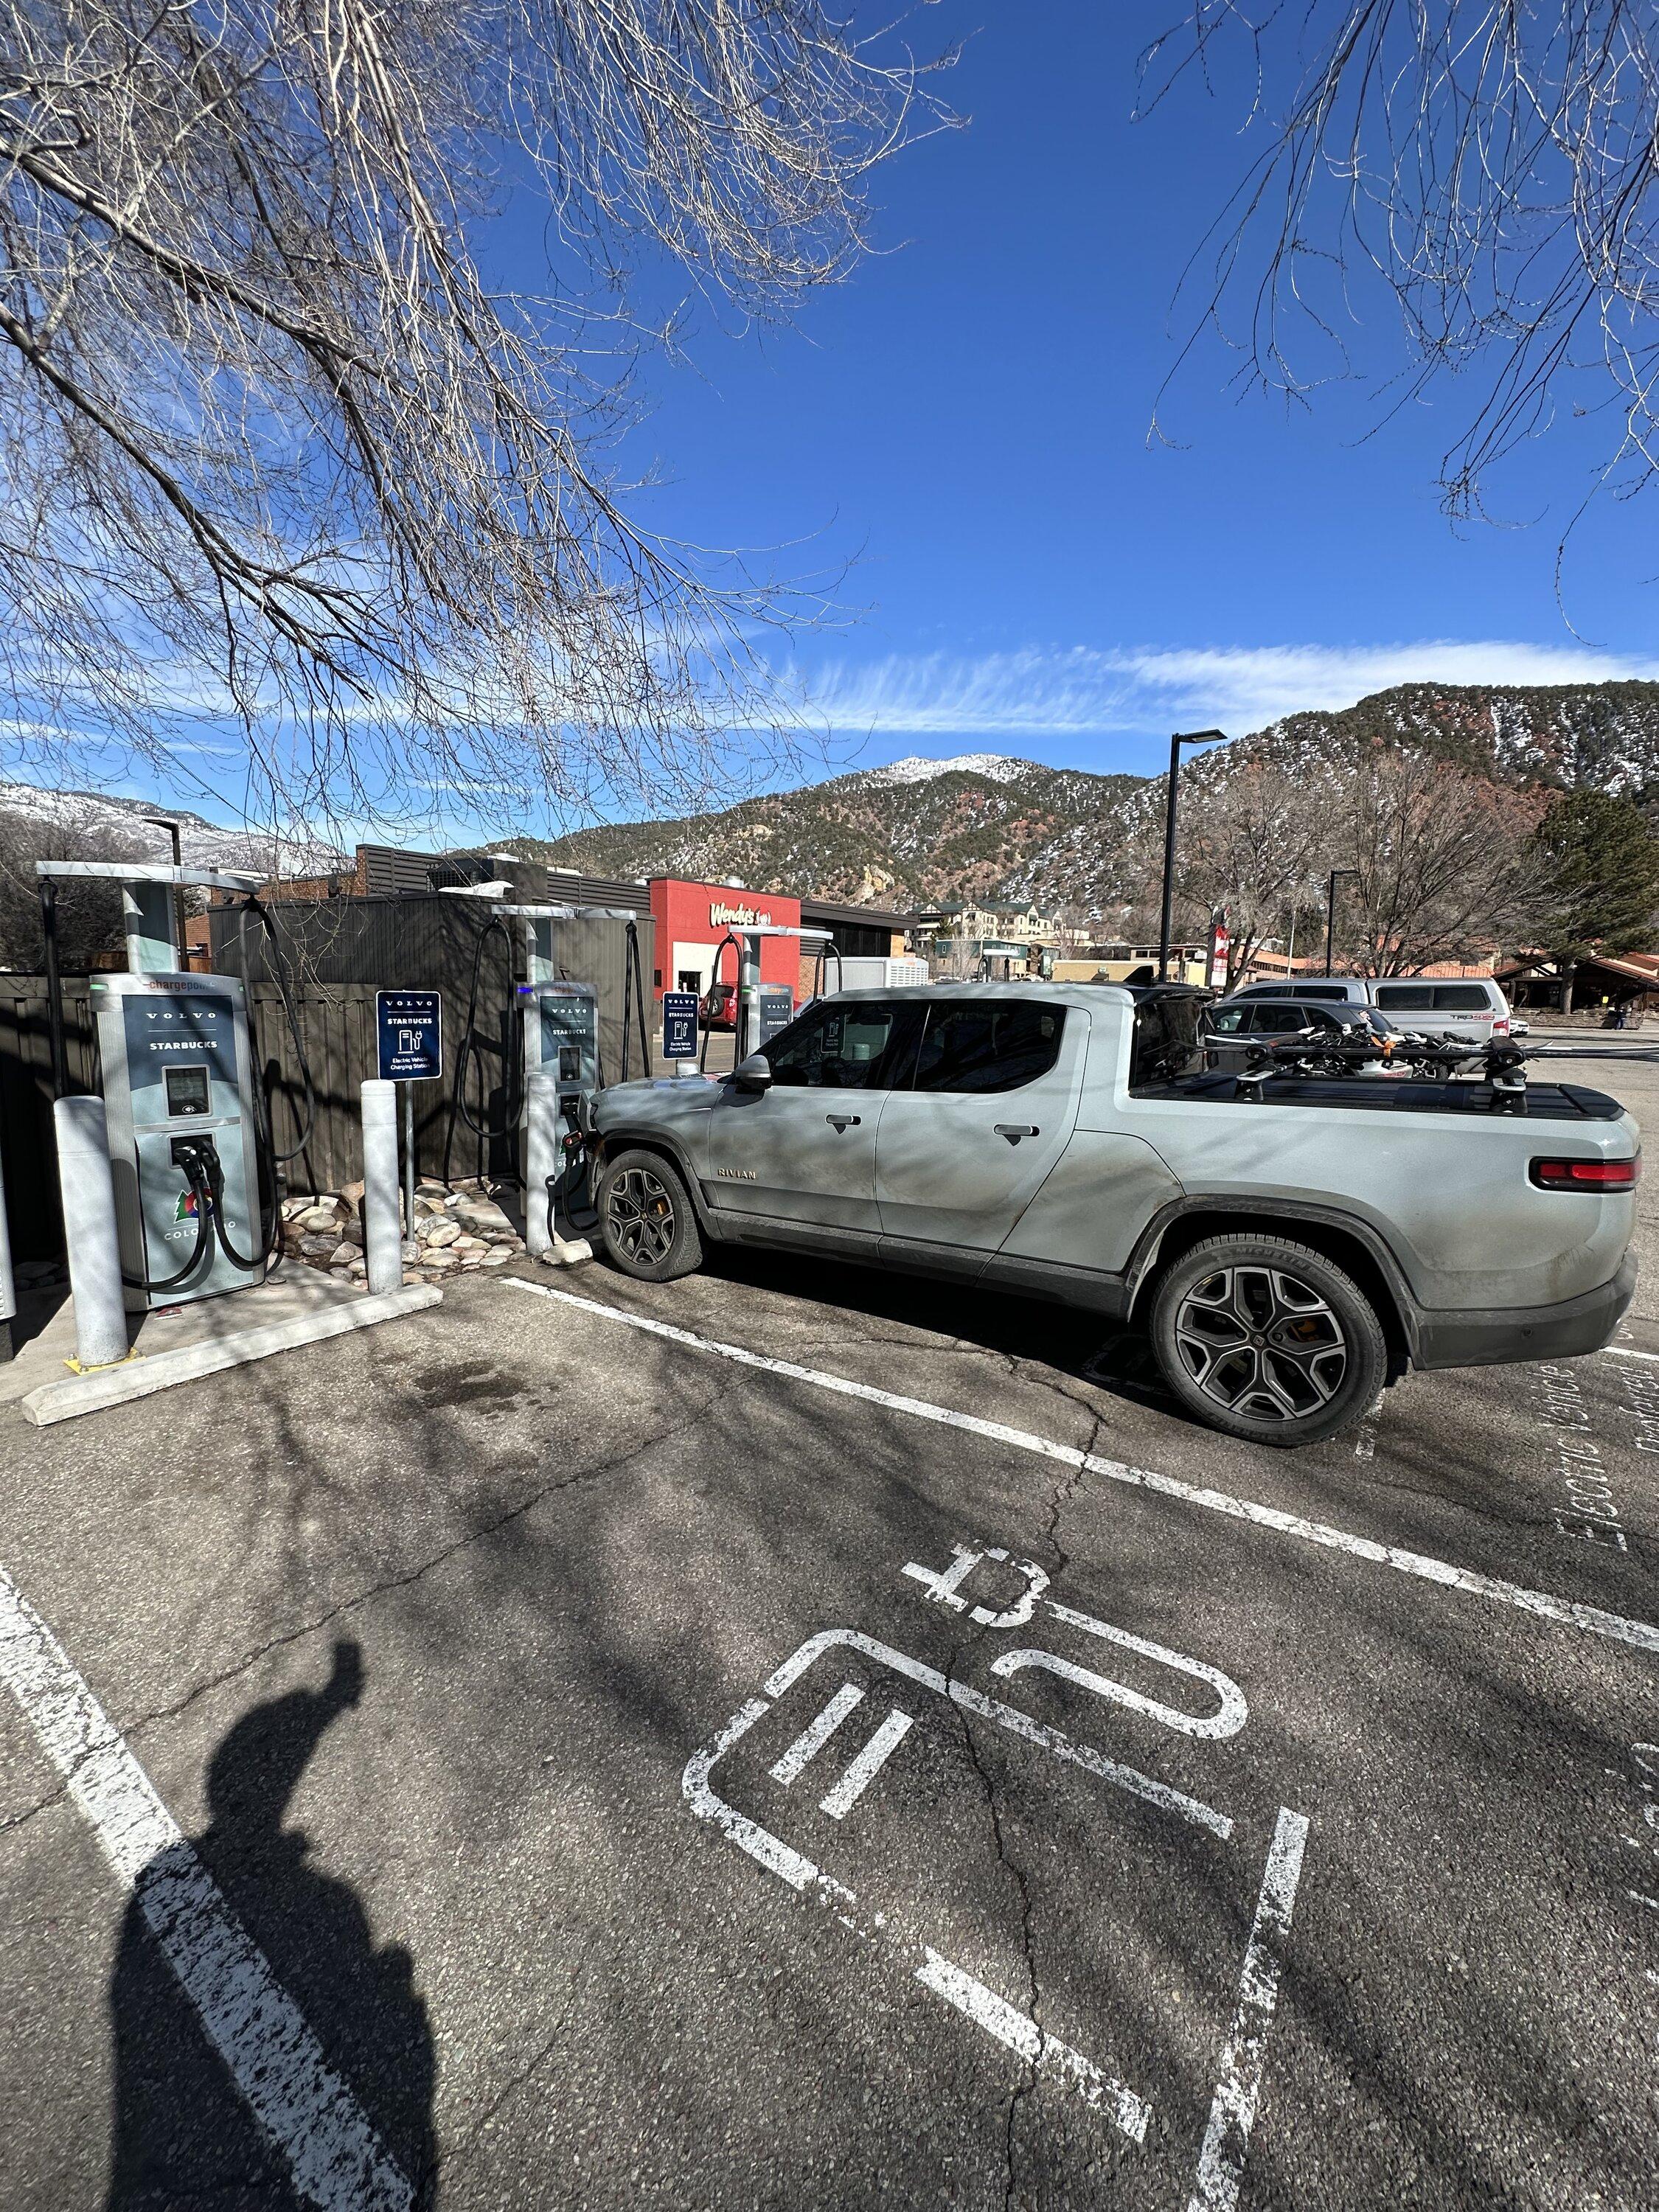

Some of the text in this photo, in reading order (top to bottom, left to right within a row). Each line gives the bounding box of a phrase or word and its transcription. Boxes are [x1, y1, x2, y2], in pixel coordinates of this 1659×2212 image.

[710, 902, 755, 926] Wendy's
[150, 1041, 218, 1050] STARBUCKS
[717, 1167, 757, 1180] RIVIAN
[164, 1220, 237, 1241] COLOO
